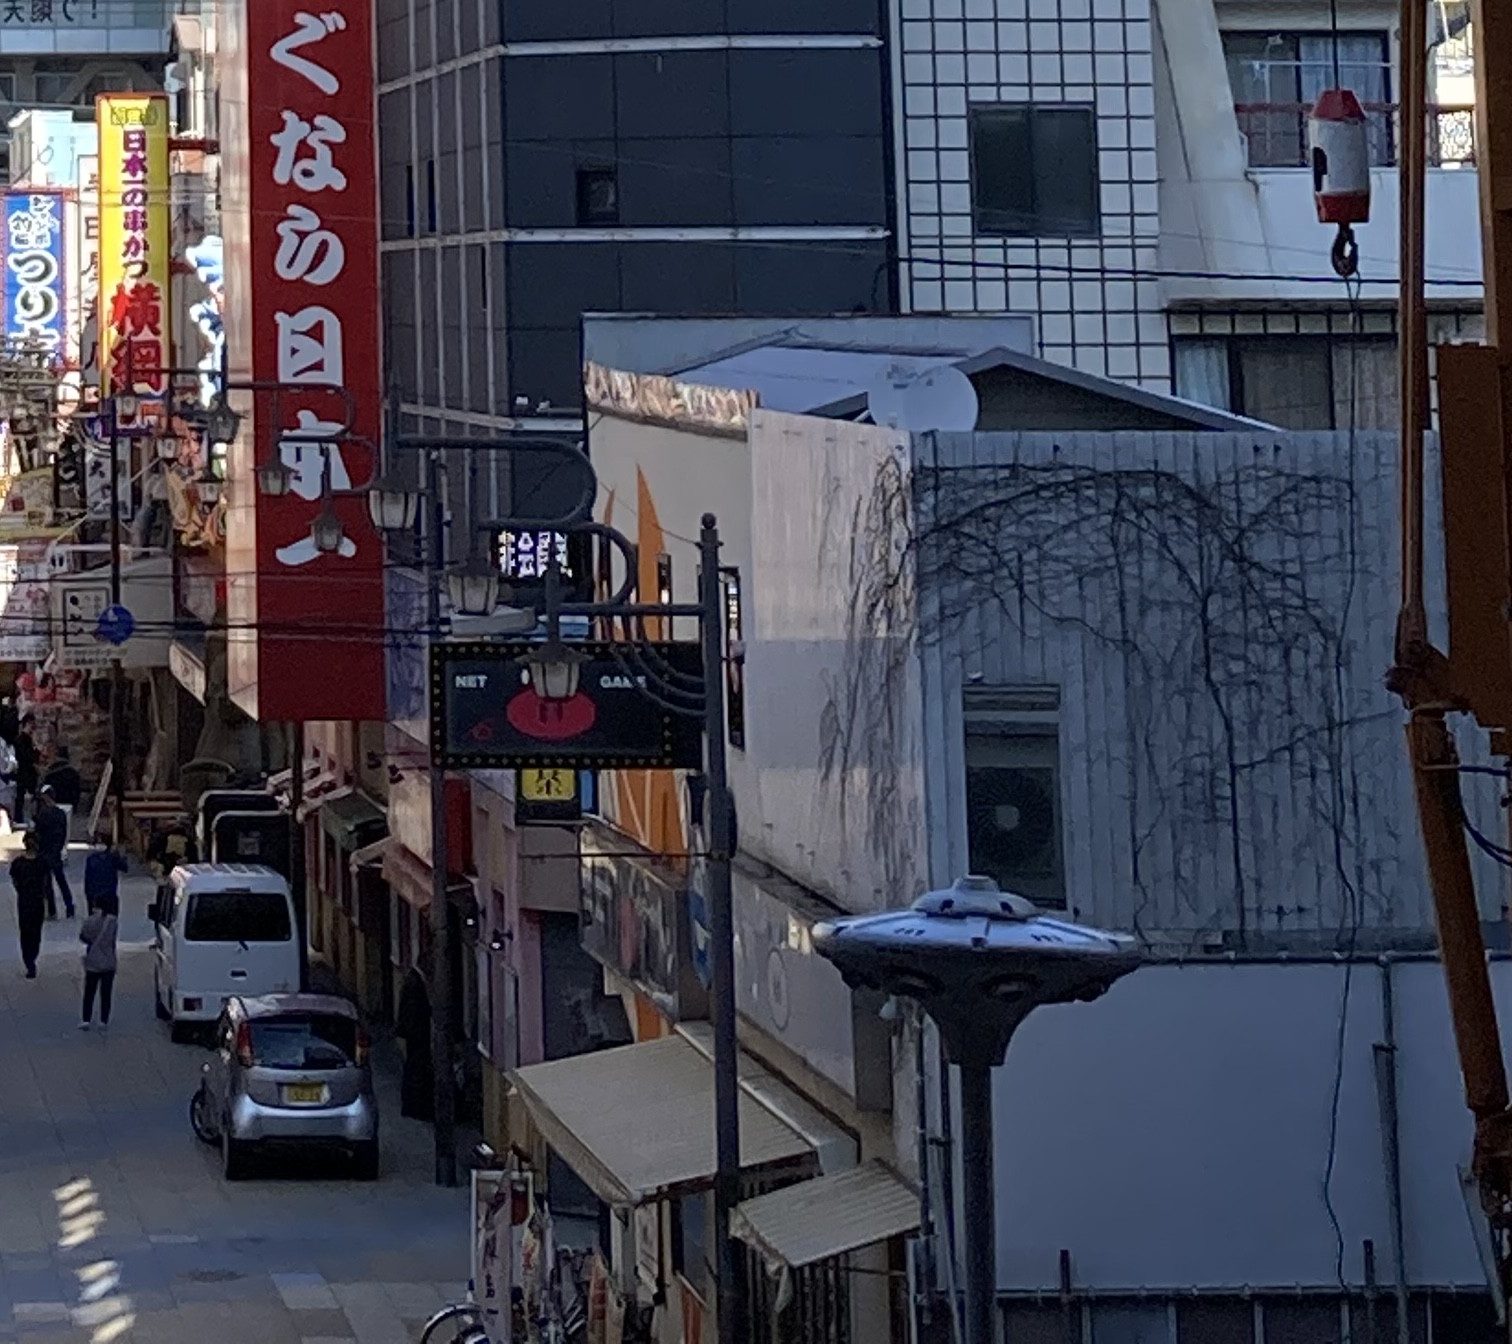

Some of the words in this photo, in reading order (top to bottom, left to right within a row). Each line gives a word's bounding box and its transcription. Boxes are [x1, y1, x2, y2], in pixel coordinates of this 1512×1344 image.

[121, 129, 150, 279] 日本一の串かつ
[110, 281, 163, 394] 横綱
[455, 675, 488, 688] NET
